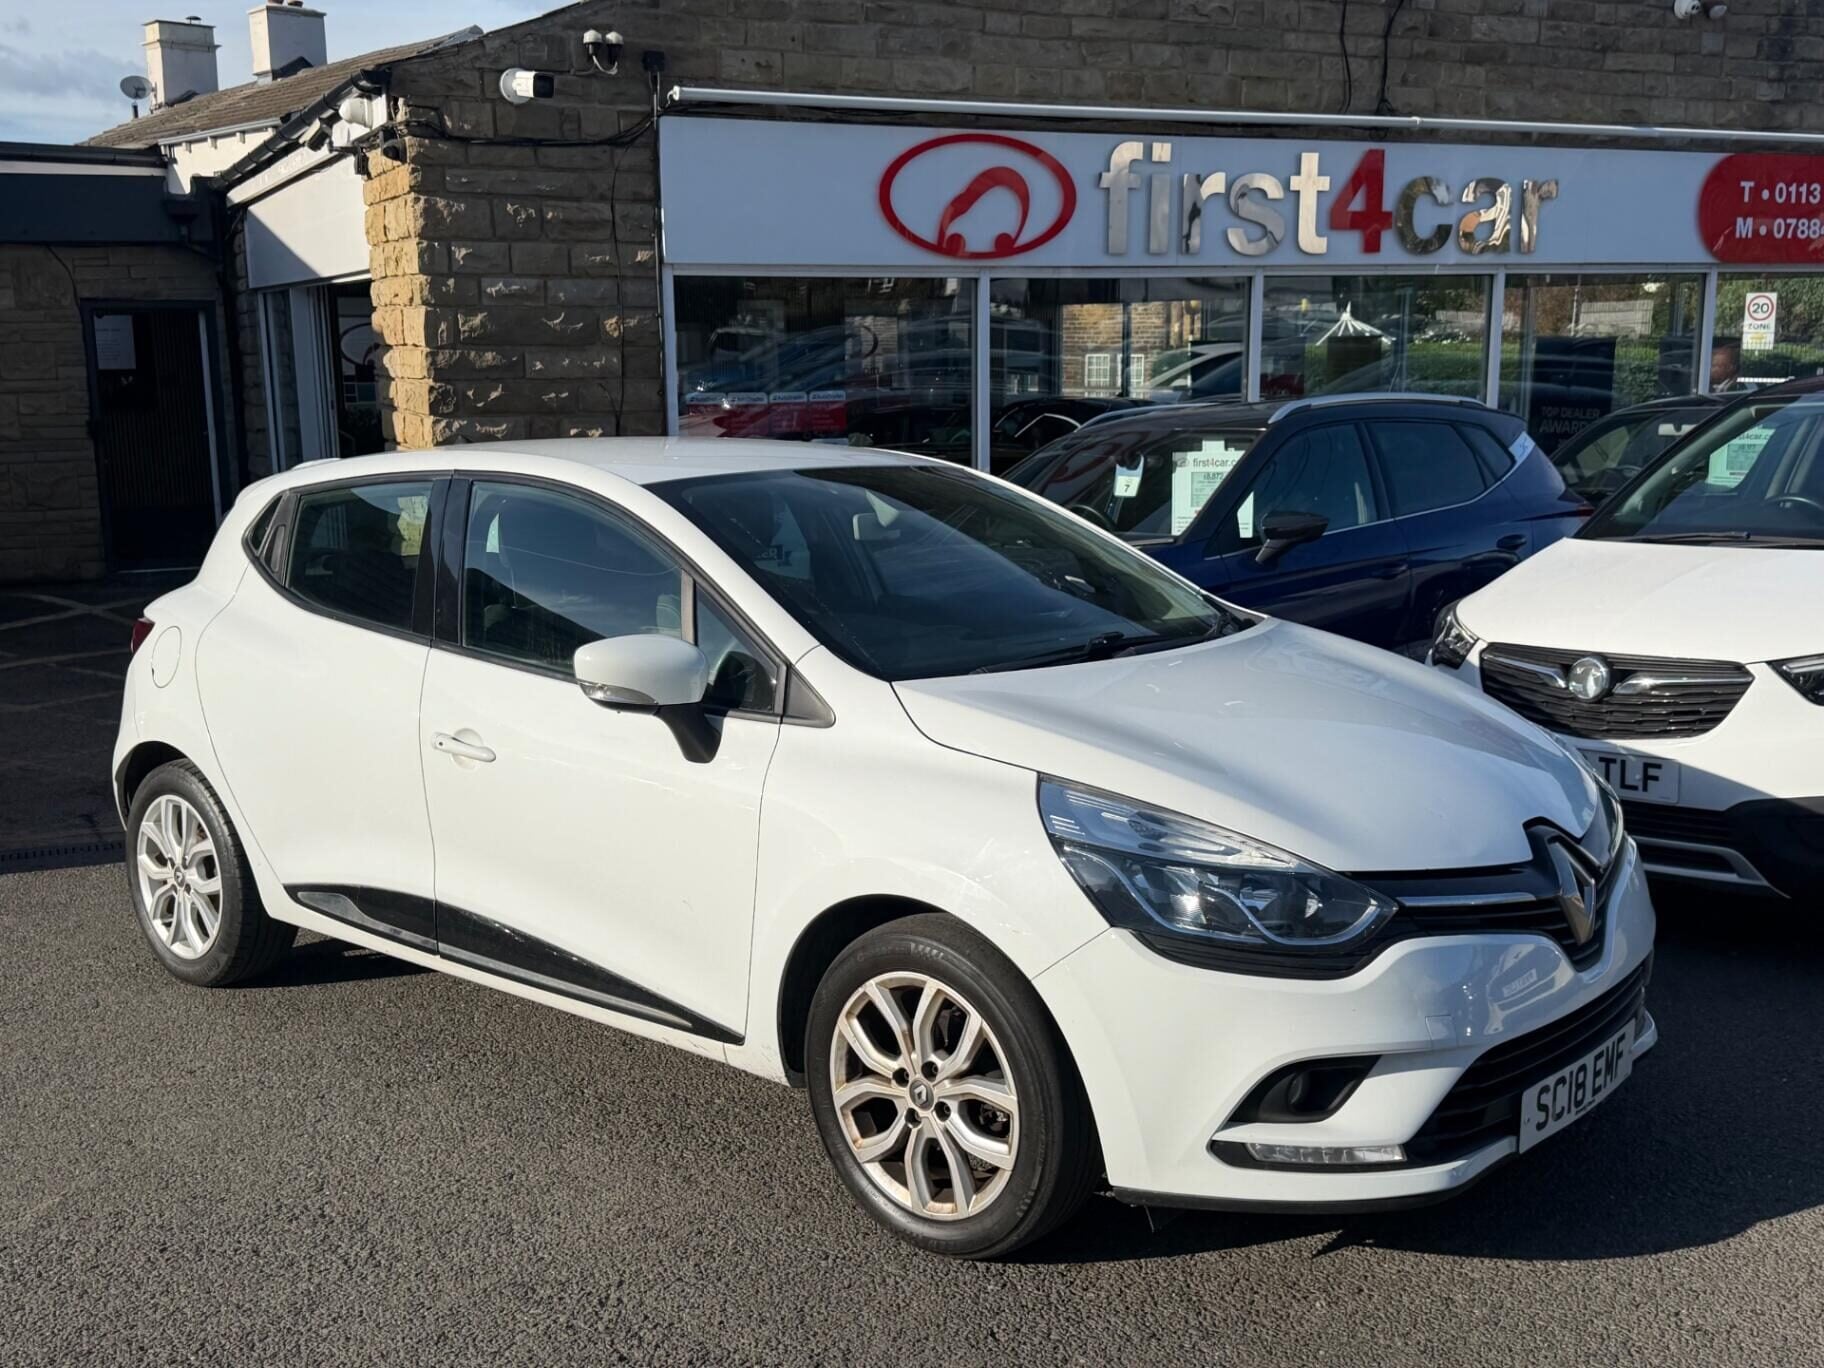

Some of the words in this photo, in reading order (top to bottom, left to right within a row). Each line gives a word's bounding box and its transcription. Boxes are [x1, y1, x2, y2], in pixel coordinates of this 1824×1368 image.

[1099, 141, 1559, 256] first4car
[1740, 181, 1755, 203] T
[1774, 182, 1821, 204] 0113
[1735, 217, 1754, 239] M
[1751, 302, 1770, 314] 20
[1598, 756, 1662, 792] TLF
[1535, 1063, 1587, 1132] SC18
[1591, 1032, 1626, 1098] EMF
